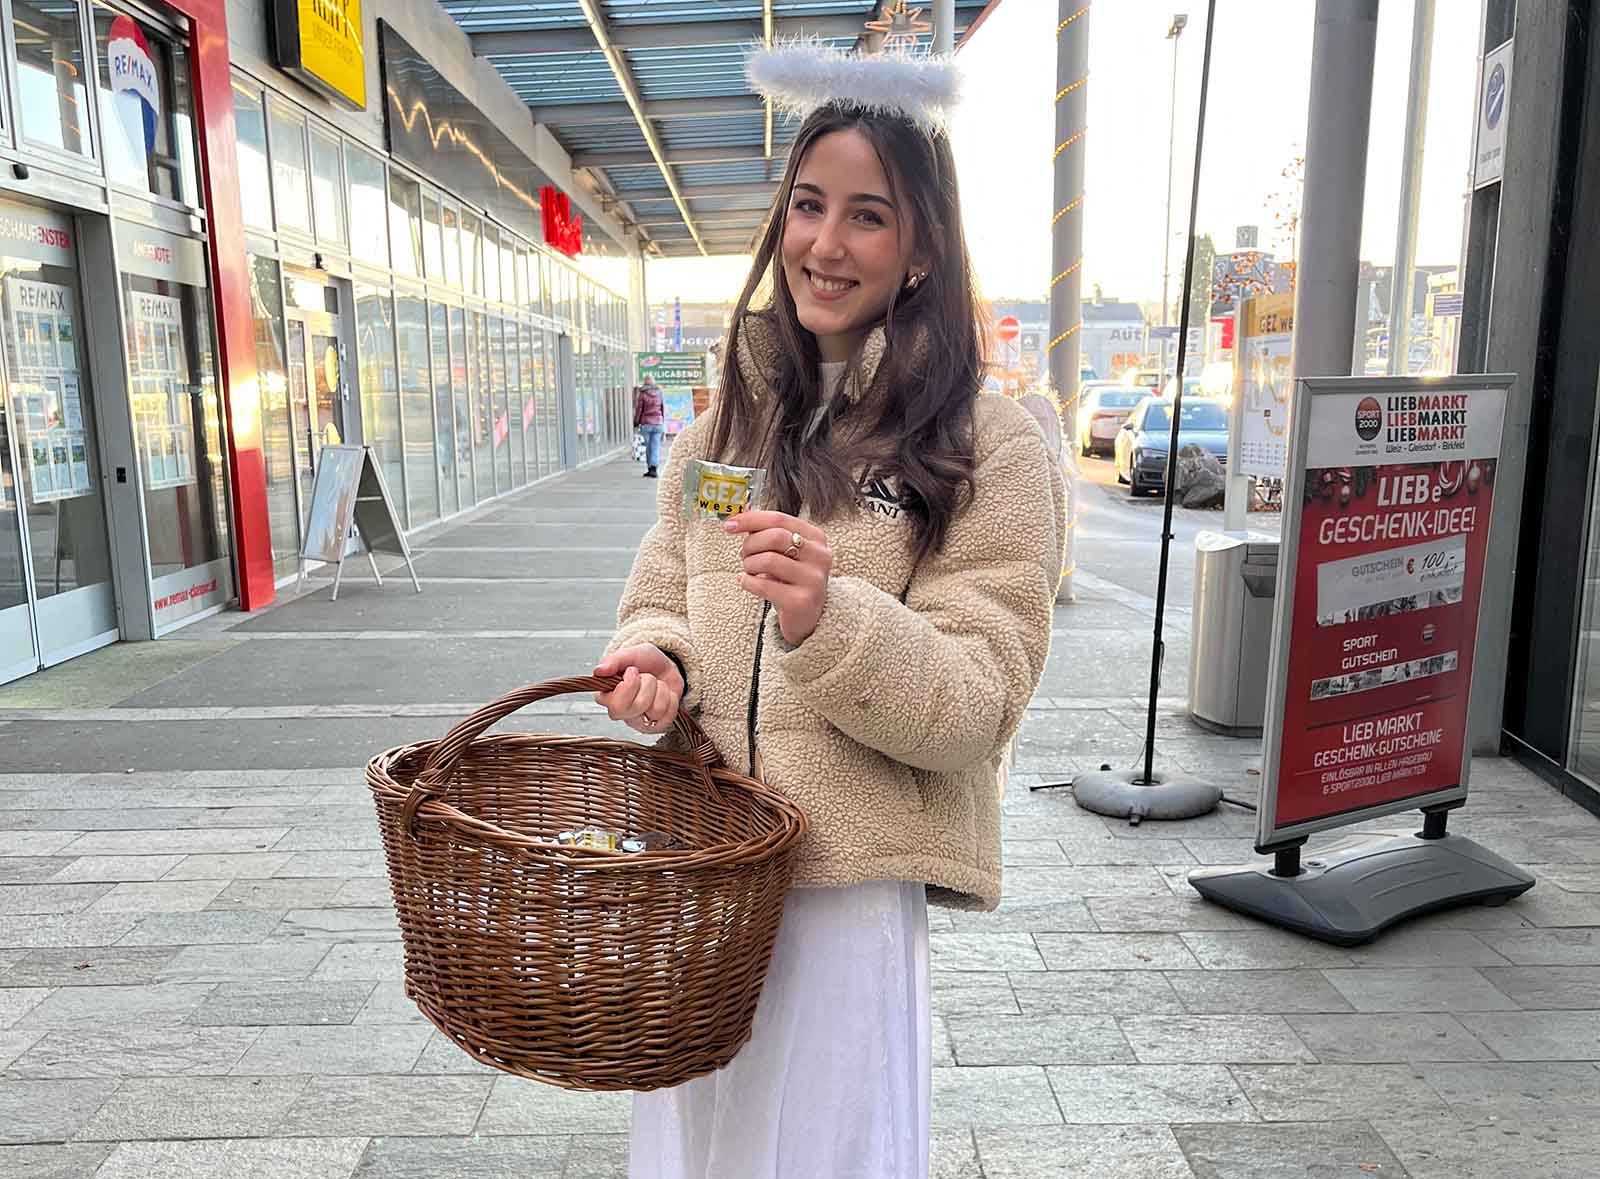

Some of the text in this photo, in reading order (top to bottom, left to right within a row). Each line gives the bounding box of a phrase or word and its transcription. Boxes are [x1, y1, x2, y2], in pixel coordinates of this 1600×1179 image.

[21, 286, 64, 311] RE/MAX
[1387, 395, 1468, 412] LIEBMARKT
[1358, 409, 1380, 420] SPORT
[1386, 410, 1467, 427] LIEBMARKT
[1359, 420, 1378, 428] 2000
[1386, 425, 1467, 442] LIEBMARKT
[703, 480, 745, 504] GEZ
[700, 500, 743, 513] west
[1319, 506, 1477, 545] GESCHENK-IDEE!
[1352, 557, 1404, 577] GUTSCHEIN
[1343, 635, 1378, 651] SPORT
[1342, 648, 1398, 669] GUTSCHEIN
[1343, 712, 1423, 743] LIEB MARKT
[1314, 728, 1443, 768] GESCHENK-GUTSCHEINE
